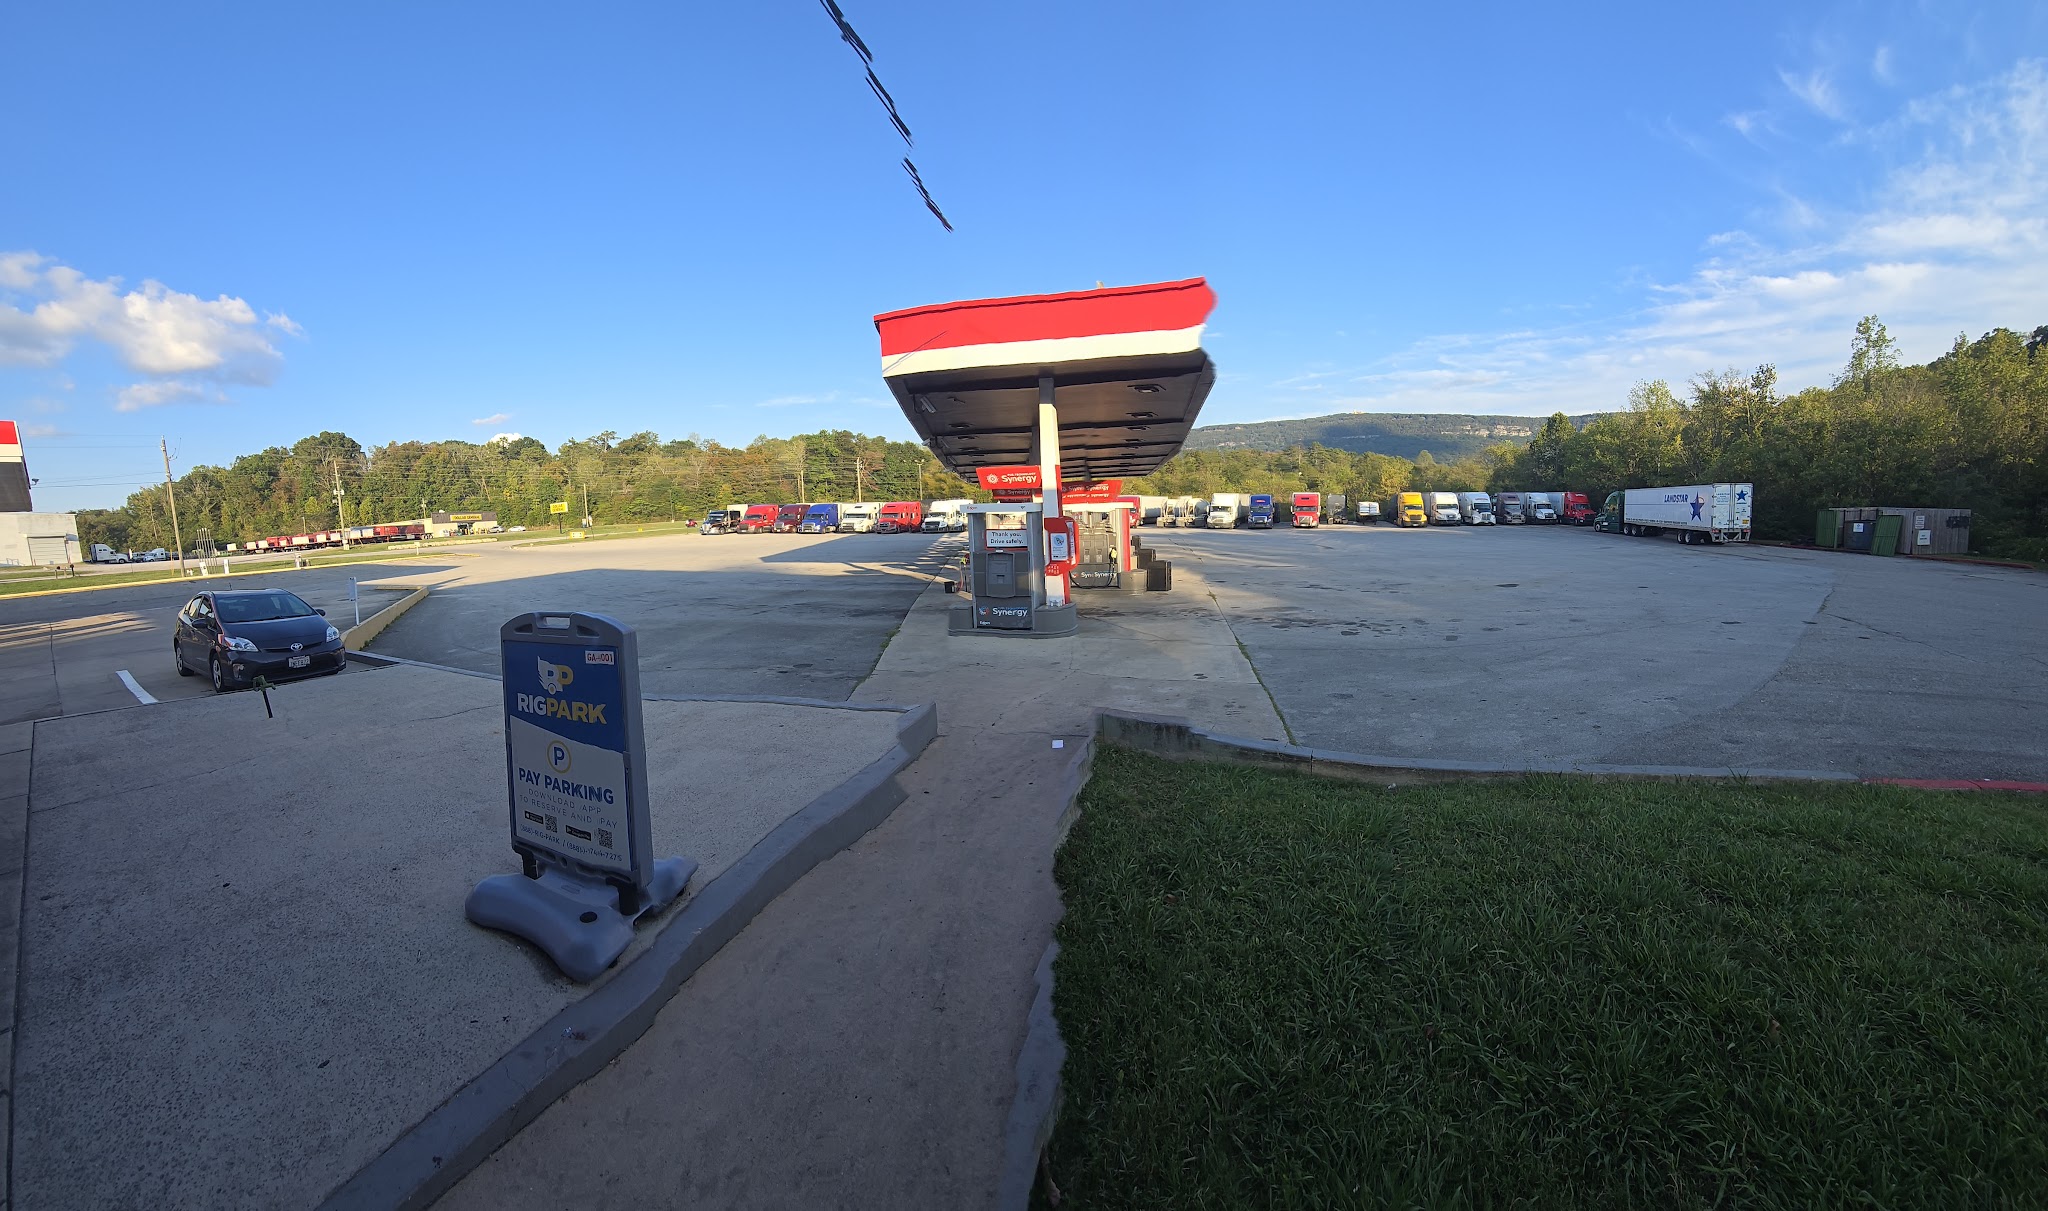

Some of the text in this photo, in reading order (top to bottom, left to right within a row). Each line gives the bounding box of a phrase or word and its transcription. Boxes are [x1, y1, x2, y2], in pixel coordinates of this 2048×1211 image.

[1001, 475, 1037, 484] Synergy
[1664, 494, 1689, 503] LANDSTAR
[992, 607, 1028, 617] Synergy
[517, 692, 607, 724] RIGPARK
[518, 767, 614, 805] PAY PARKING
[528, 788, 575, 808] DOWNLOAD
[520, 794, 529, 803] TO
[531, 798, 567, 817] RESERVE
[600, 817, 618, 829] PAY
